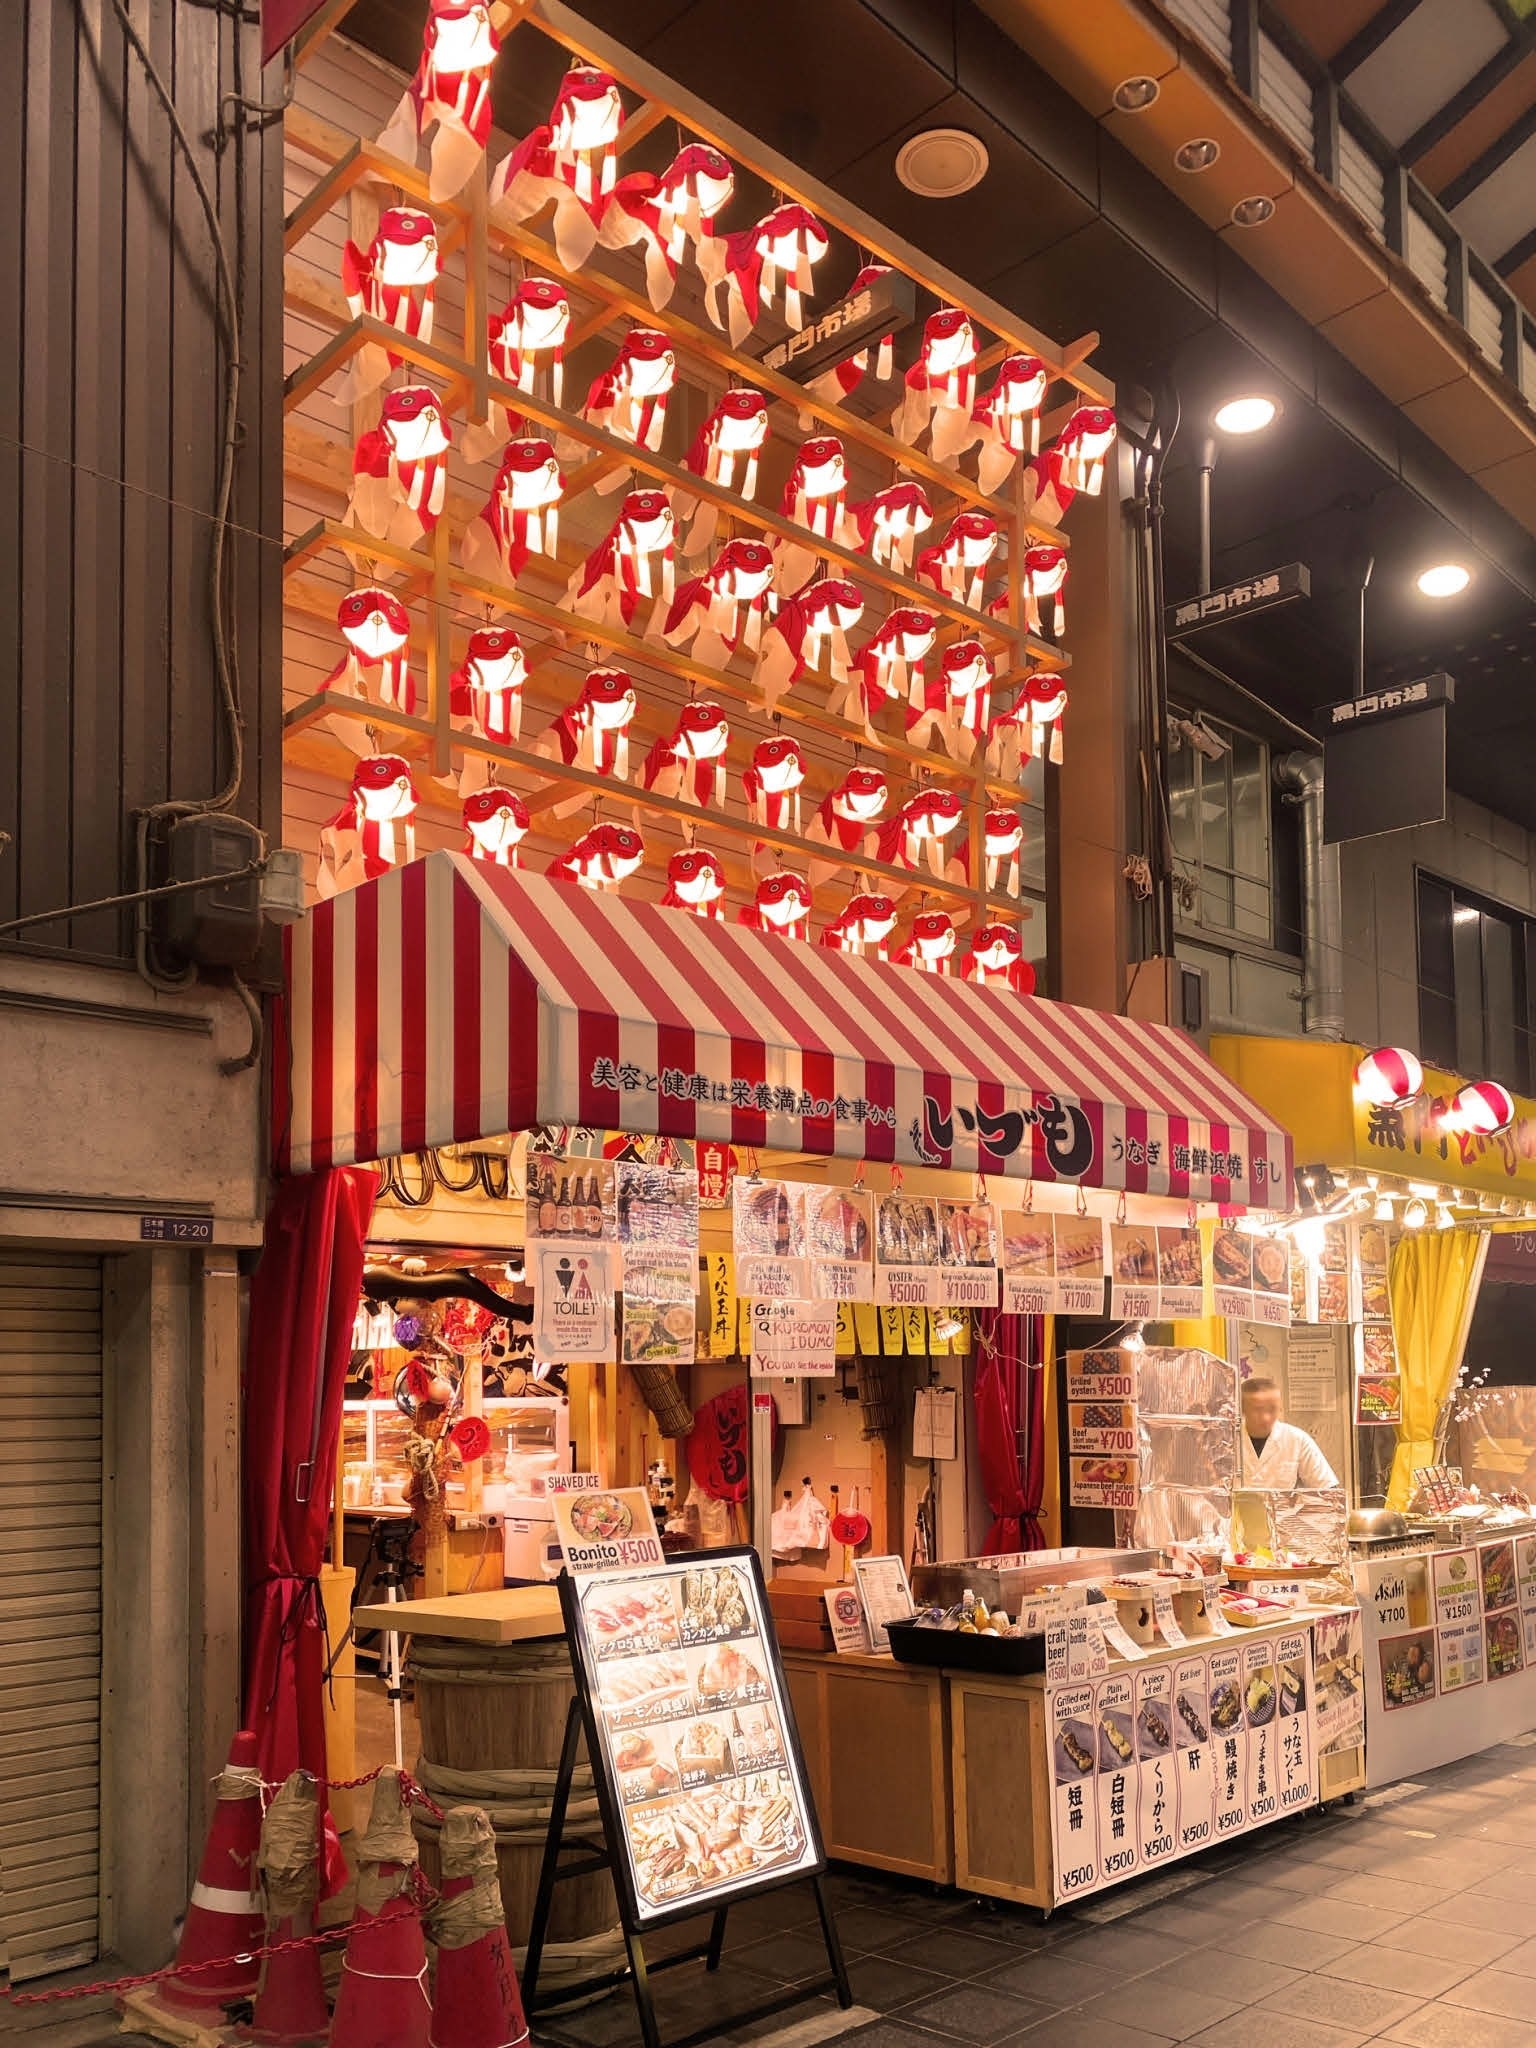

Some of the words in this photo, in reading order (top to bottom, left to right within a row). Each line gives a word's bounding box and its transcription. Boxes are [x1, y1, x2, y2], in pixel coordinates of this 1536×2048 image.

[1176, 574, 1280, 626] 黒門市場
[1332, 682, 1428, 722] 黒門市場
[591, 1057, 897, 1128] 美容と健康は栄養満点の食事から
[923, 1093, 1095, 1177] いづも
[1111, 1135, 1161, 1166] うなぎ
[1173, 1144, 1243, 1182] 海鮮浜焼
[1254, 1158, 1282, 1185] すし
[702, 1146, 727, 1199] 自慢
[173, 1224, 209, 1237] 12-20
[946, 1282, 986, 1300] ¥10000
[1064, 1291, 1091, 1309] ¥1700
[553, 1301, 597, 1316] TOILET
[1013, 1293, 1043, 1313] ¥3500
[1122, 1300, 1150, 1318] ¥1500
[773, 1321, 832, 1336] KUROMON
[756, 1354, 780, 1372] You
[1070, 1376, 1092, 1386] Grilled
[1098, 1376, 1132, 1396] ¥500
[1071, 1386, 1097, 1397] oysters
[1072, 1428, 1088, 1437] Beef
[1101, 1430, 1134, 1450] ¥700
[548, 1475, 584, 1489] SHAVED
[586, 1475, 599, 1488] ICE
[1073, 1481, 1100, 1490] Japanese
[1101, 1481, 1115, 1490] beef
[1102, 1490, 1134, 1507] ¥1500
[567, 1544, 618, 1562] Bonito
[616, 1538, 660, 1565] ¥500
[572, 1558, 620, 1571] straw-grilled
[1375, 1579, 1405, 1602] Asahi
[1379, 1606, 1405, 1624] ¥700
[1446, 1603, 1472, 1620] ¥1500
[1069, 1617, 1087, 1631] SOUR
[1047, 1628, 1067, 1645] craft
[1280, 1640, 1290, 1651] Eel
[1048, 1647, 1066, 1660] beer
[1211, 1659, 1221, 1669] Eel
[1142, 1677, 1148, 1685] A
[1148, 1673, 1166, 1686] piece
[1179, 1671, 1189, 1681] Eel
[1106, 1684, 1122, 1695] Plain
[1144, 1687, 1152, 1696] of
[1152, 1683, 1162, 1694] eel
[1057, 1693, 1080, 1707] Grilled
[1079, 1691, 1091, 1702] eel
[1098, 1694, 1119, 1709] grilled
[1119, 1690, 1130, 1702] eel
[1056, 1707, 1072, 1718] with
[1072, 1703, 1091, 1714] sauce
[1292, 1717, 1303, 1766] うな玉
[1188, 1749, 1201, 1771] 肝
[1257, 1729, 1267, 1798] うまき串
[1283, 1735, 1294, 1785] サンド
[1224, 1738, 1238, 1801] 鰻焼き
[1152, 1761, 1166, 1835] くりから
[1281, 1783, 1309, 1805] ¥1,000
[1068, 1786, 1084, 1832] 短冊
[1110, 1773, 1125, 1840] 白短冊
[1251, 1796, 1275, 1817] ¥500
[1218, 1808, 1243, 1831] ¥500
[1182, 1821, 1209, 1844] ¥500
[1144, 1834, 1173, 1858] ¥500
[1104, 1849, 1134, 1874] ¥500
[1063, 1864, 1094, 1890] ¥500
